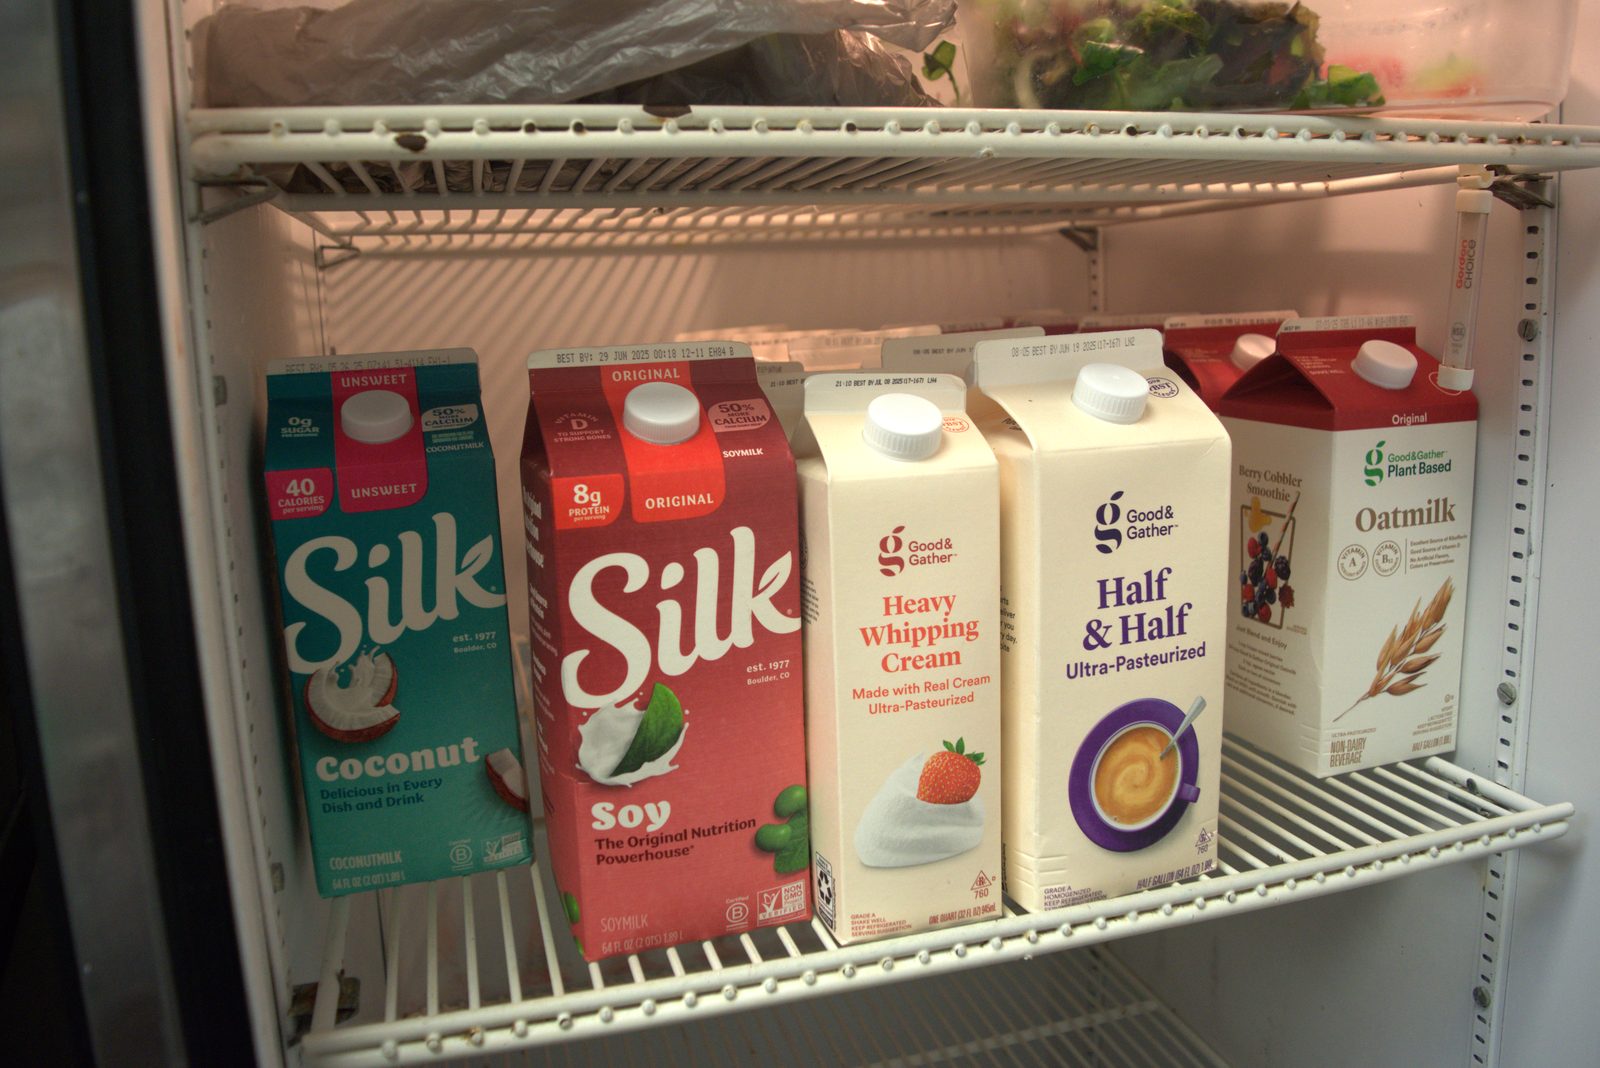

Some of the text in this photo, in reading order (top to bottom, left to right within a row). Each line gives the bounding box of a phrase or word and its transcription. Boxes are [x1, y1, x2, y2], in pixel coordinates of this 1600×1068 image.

[1464, 240, 1476, 289] CHOICE
[556, 354, 575, 364] BEST
[580, 353, 594, 363] BY:
[599, 352, 609, 362] 29
[614, 351, 628, 361] JUN
[632, 350, 650, 361] 2025
[682, 348, 704, 358] 12-11
[340, 374, 408, 388] UNSWEET
[611, 368, 681, 382] ORIGINAL
[853, 379, 867, 387] BEST
[432, 406, 465, 418] 50%
[718, 403, 755, 414] 50%
[288, 416, 312, 430] 0g
[424, 417, 475, 428] CALCIUM
[571, 418, 589, 431] D
[714, 415, 767, 426] CALCIUM
[1391, 413, 1428, 427] Original
[280, 426, 320, 436] SUGAR
[425, 441, 485, 454] COCONUTMILK
[722, 448, 764, 459] SOYMILK
[1239, 465, 1303, 488] Berry Cobbler
[1387, 460, 1452, 478] Plant Based
[285, 478, 316, 498] 40
[350, 483, 417, 500] UNSWEET
[572, 484, 602, 507] 8g
[1246, 483, 1291, 502] Smoothie
[277, 495, 325, 509] CALORIES
[644, 493, 715, 510] ORIGINAL
[568, 505, 610, 518] PROTEIN
[1355, 497, 1456, 533] Oatmilk
[1126, 523, 1174, 540] Gather
[1375, 543, 1399, 556] VITAMIN
[908, 552, 953, 567] Gather
[1348, 557, 1357, 568] A
[284, 512, 507, 675] Silk
[1097, 566, 1173, 610] Half
[882, 595, 957, 617] Heavy
[561, 526, 801, 708] Silk
[859, 617, 980, 649] Whipping
[1082, 602, 1193, 652] & Half
[452, 631, 497, 643] est. 1977
[486, 642, 497, 650] CO
[746, 659, 790, 674] est. 1977
[881, 650, 962, 673] Cream
[1066, 641, 1206, 680] Ultra-Pasteurized
[746, 671, 790, 686] Boulder, CO
[852, 675, 991, 700] Made with Real Cream
[868, 691, 975, 715] Ultra-Pasteurized
[1330, 738, 1367, 754] NON-DAIRY
[316, 736, 480, 782] Coconut
[1329, 751, 1362, 768] BEVERAGE
[320, 777, 443, 801] Delicious in Every
[322, 792, 425, 814] Dish and Drink
[591, 800, 672, 832] Soy
[595, 818, 757, 851] The Original Nutrition
[329, 850, 404, 871] COCONUTMILK
[783, 883, 802, 894] NON
[600, 914, 649, 932] SOYMILK
[602, 942, 613, 955] 64
[624, 938, 633, 951] OZ
